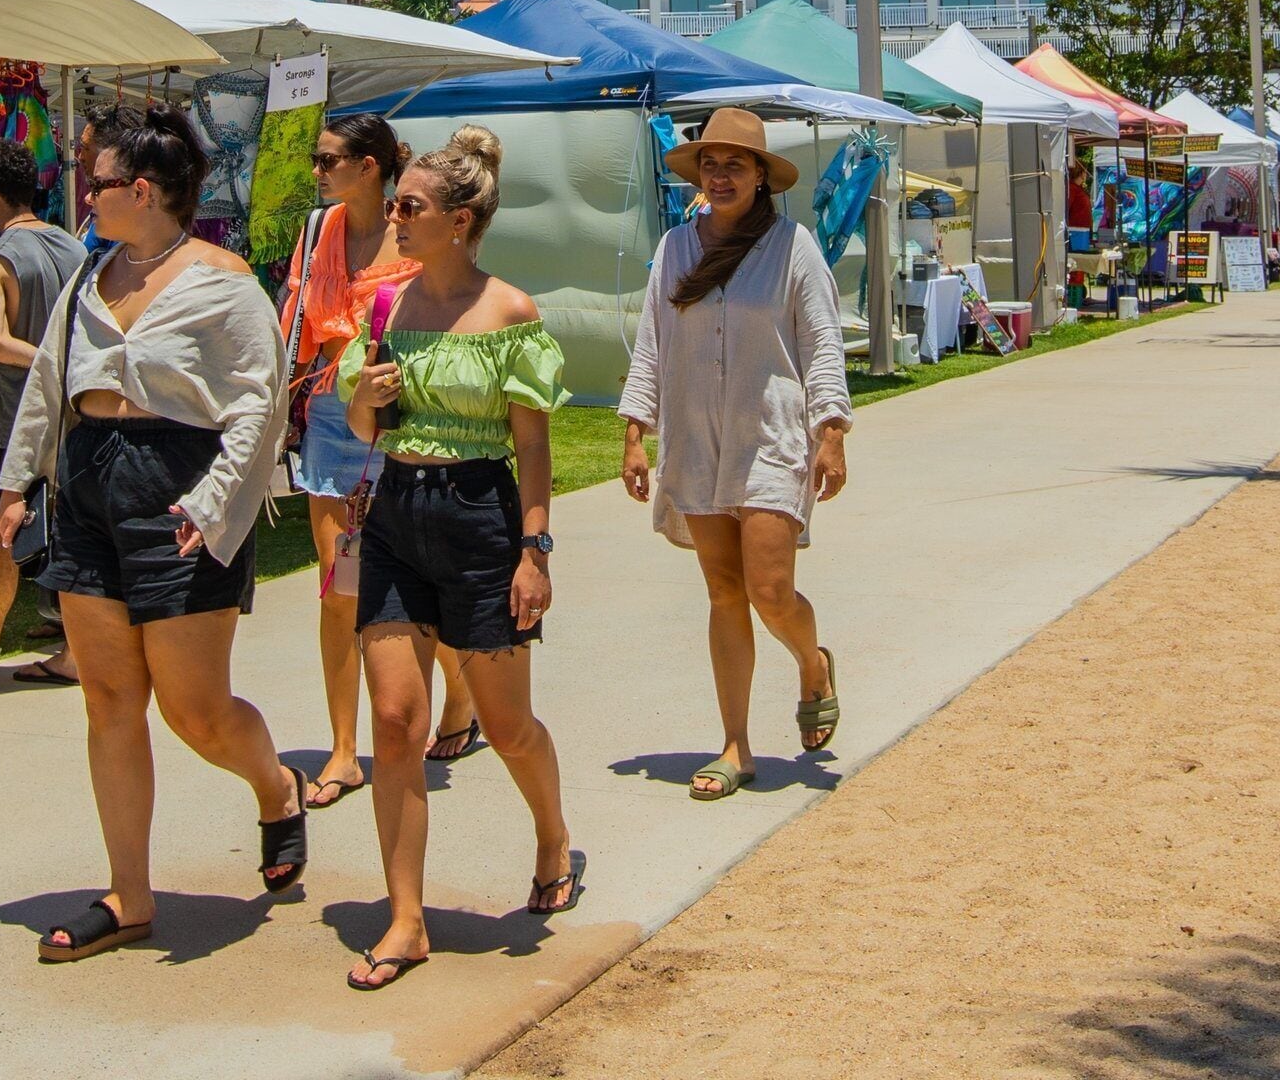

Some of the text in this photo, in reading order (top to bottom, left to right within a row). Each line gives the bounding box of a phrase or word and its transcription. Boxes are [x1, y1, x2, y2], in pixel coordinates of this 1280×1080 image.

[285, 69, 316, 81] Sarongs
[291, 315, 303, 361] SNAPSHOT
[288, 363, 296, 380] THE
